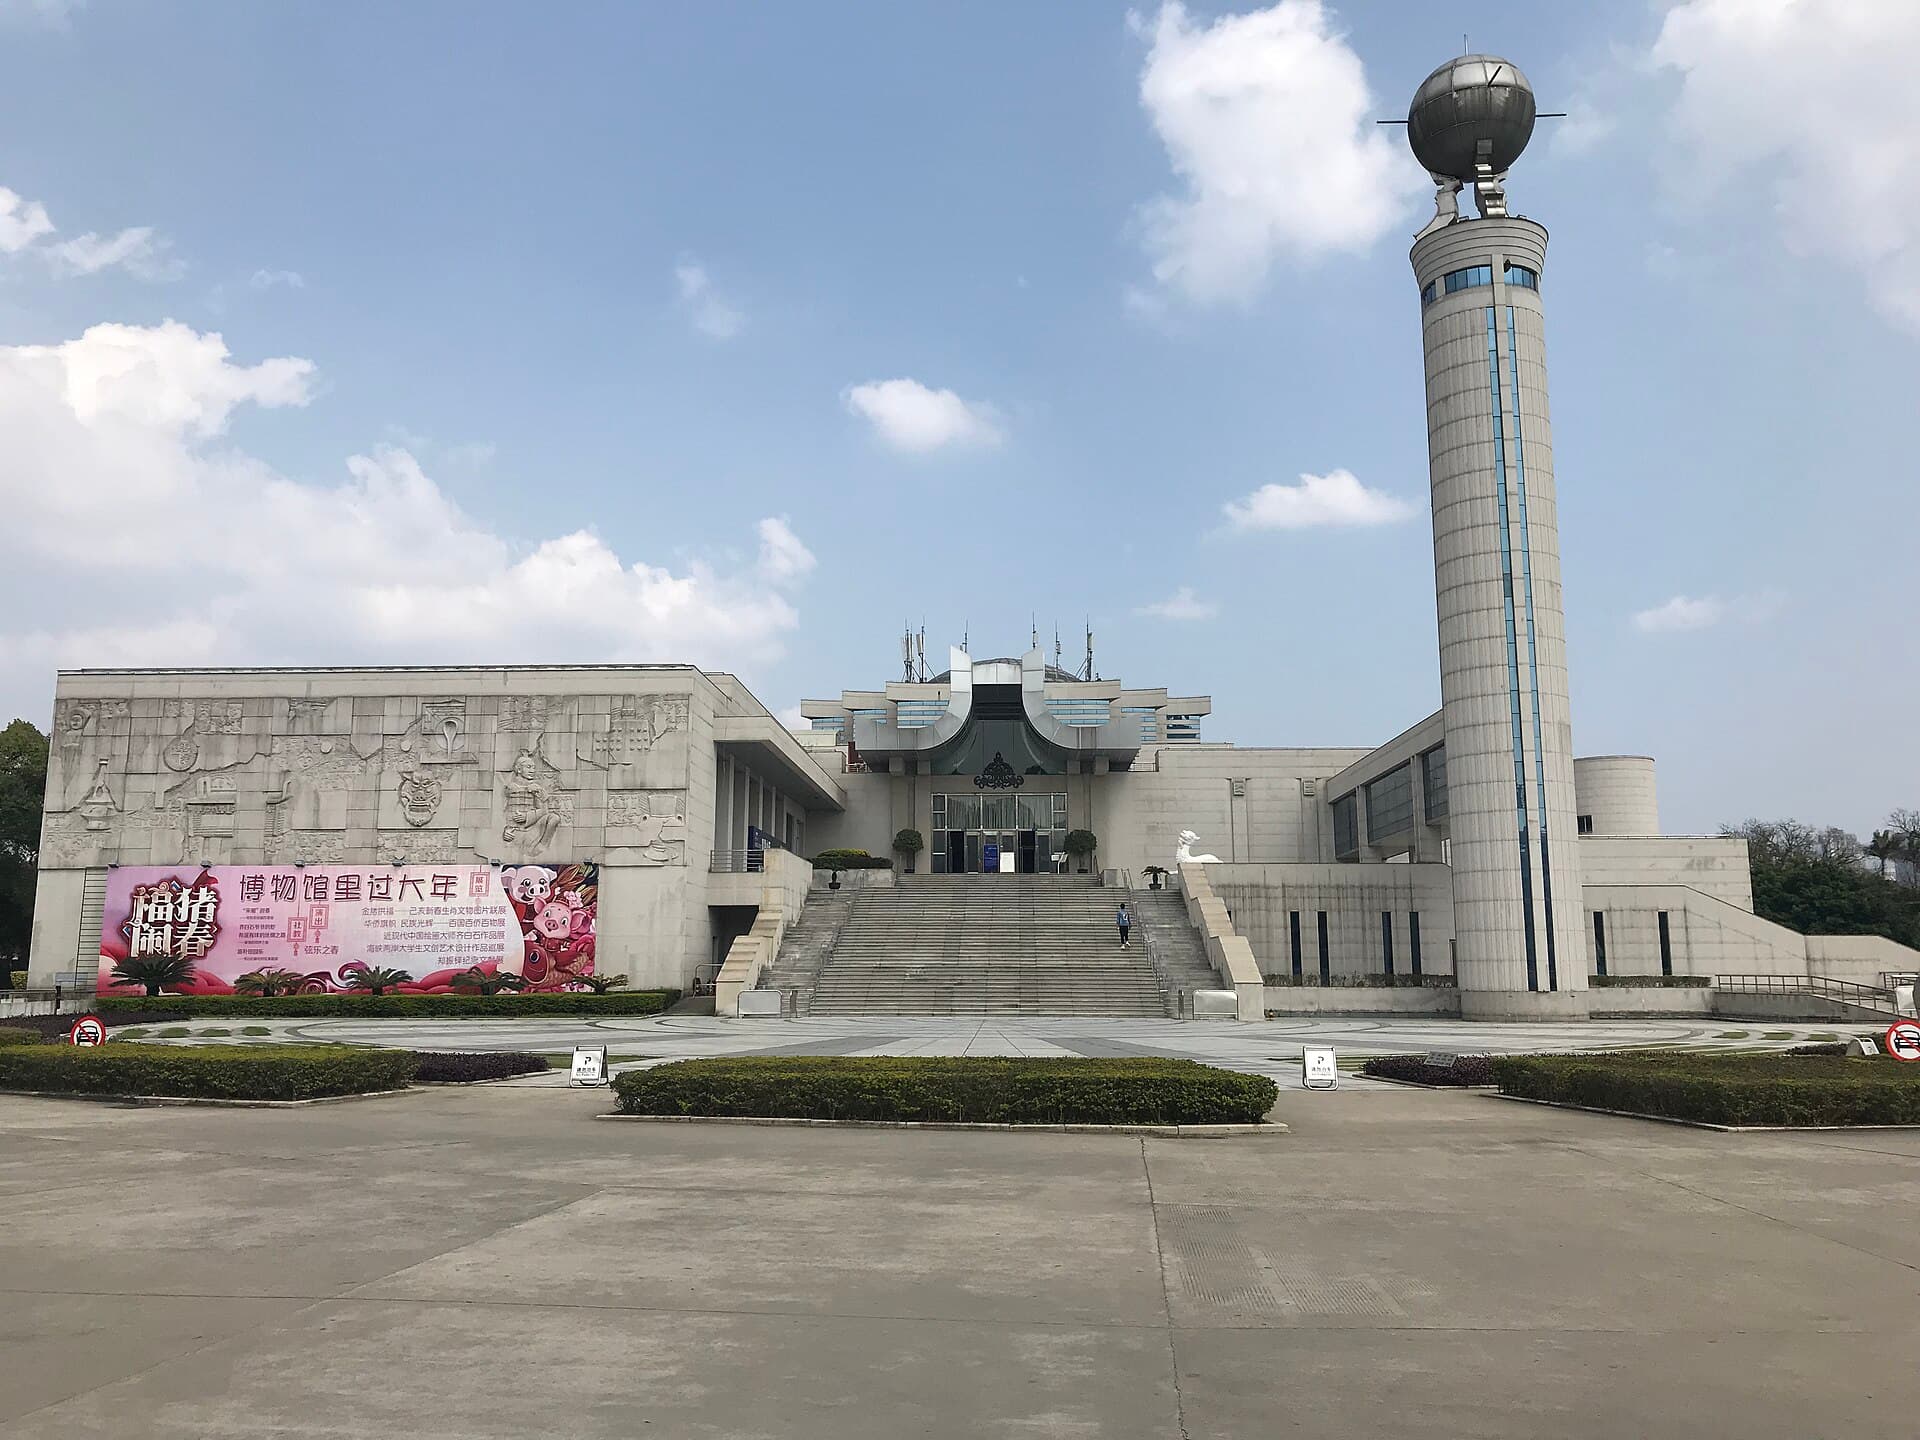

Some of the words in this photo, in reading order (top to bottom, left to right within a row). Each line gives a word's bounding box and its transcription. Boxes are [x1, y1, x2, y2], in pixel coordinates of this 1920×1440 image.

[239, 873, 459, 902] 博物馆里过大年
[474, 875, 484, 894] 展览
[132, 882, 219, 923] 福猪
[130, 921, 215, 958] 闹春
[383, 930, 505, 940] 近现代中国绘画大师齐白石作品展
[304, 945, 339, 955] 弦乐之春
[366, 943, 505, 953] 海峡两岸大学生文创艺术设计作品巡展
